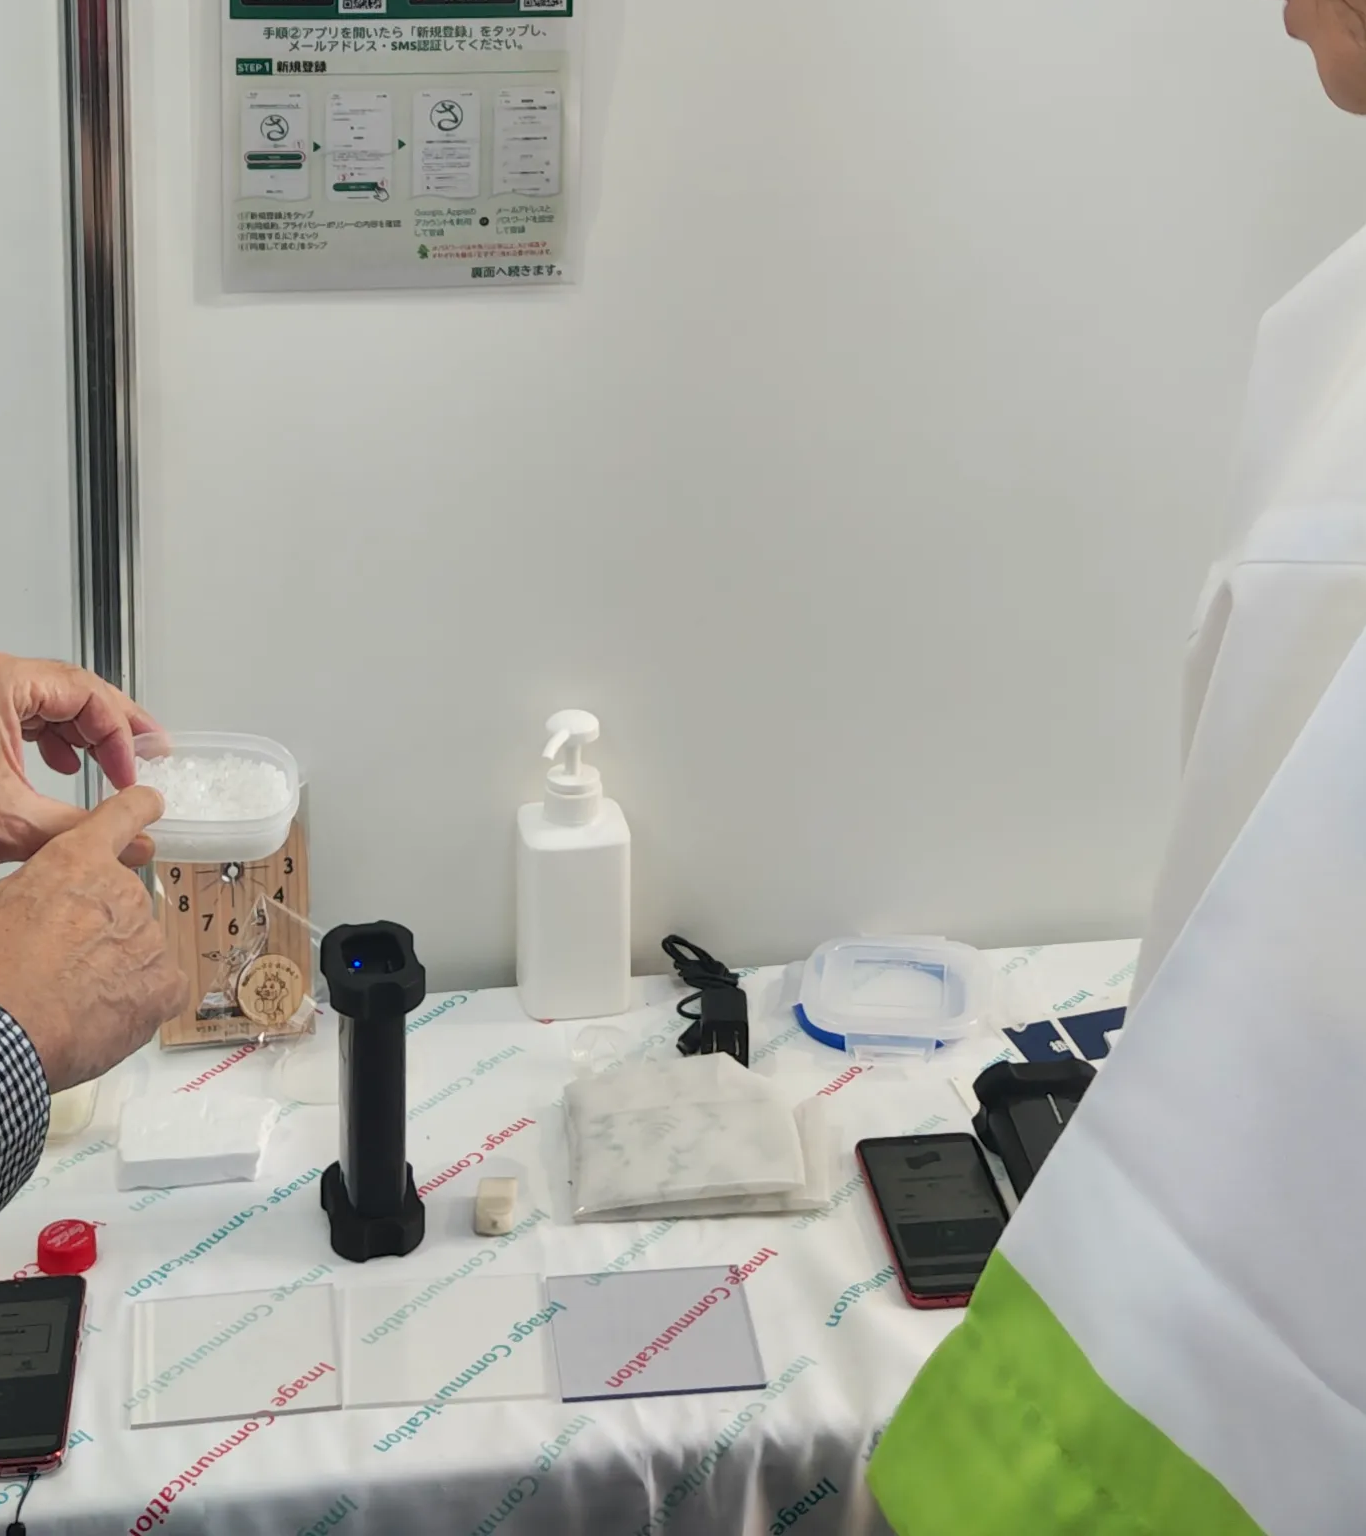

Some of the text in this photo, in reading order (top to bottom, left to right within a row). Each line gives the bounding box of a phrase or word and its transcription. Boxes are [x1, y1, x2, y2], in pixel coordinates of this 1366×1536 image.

[237, 62, 261, 73] STEP
[481, 1116, 535, 1152] Image
[267, 1167, 323, 1204] Image
[125, 1204, 269, 1297] Communication
[605, 1247, 778, 1388] Image Communication
[373, 1300, 568, 1453] Image Communication
[128, 1361, 335, 1536] Image Communicatio
